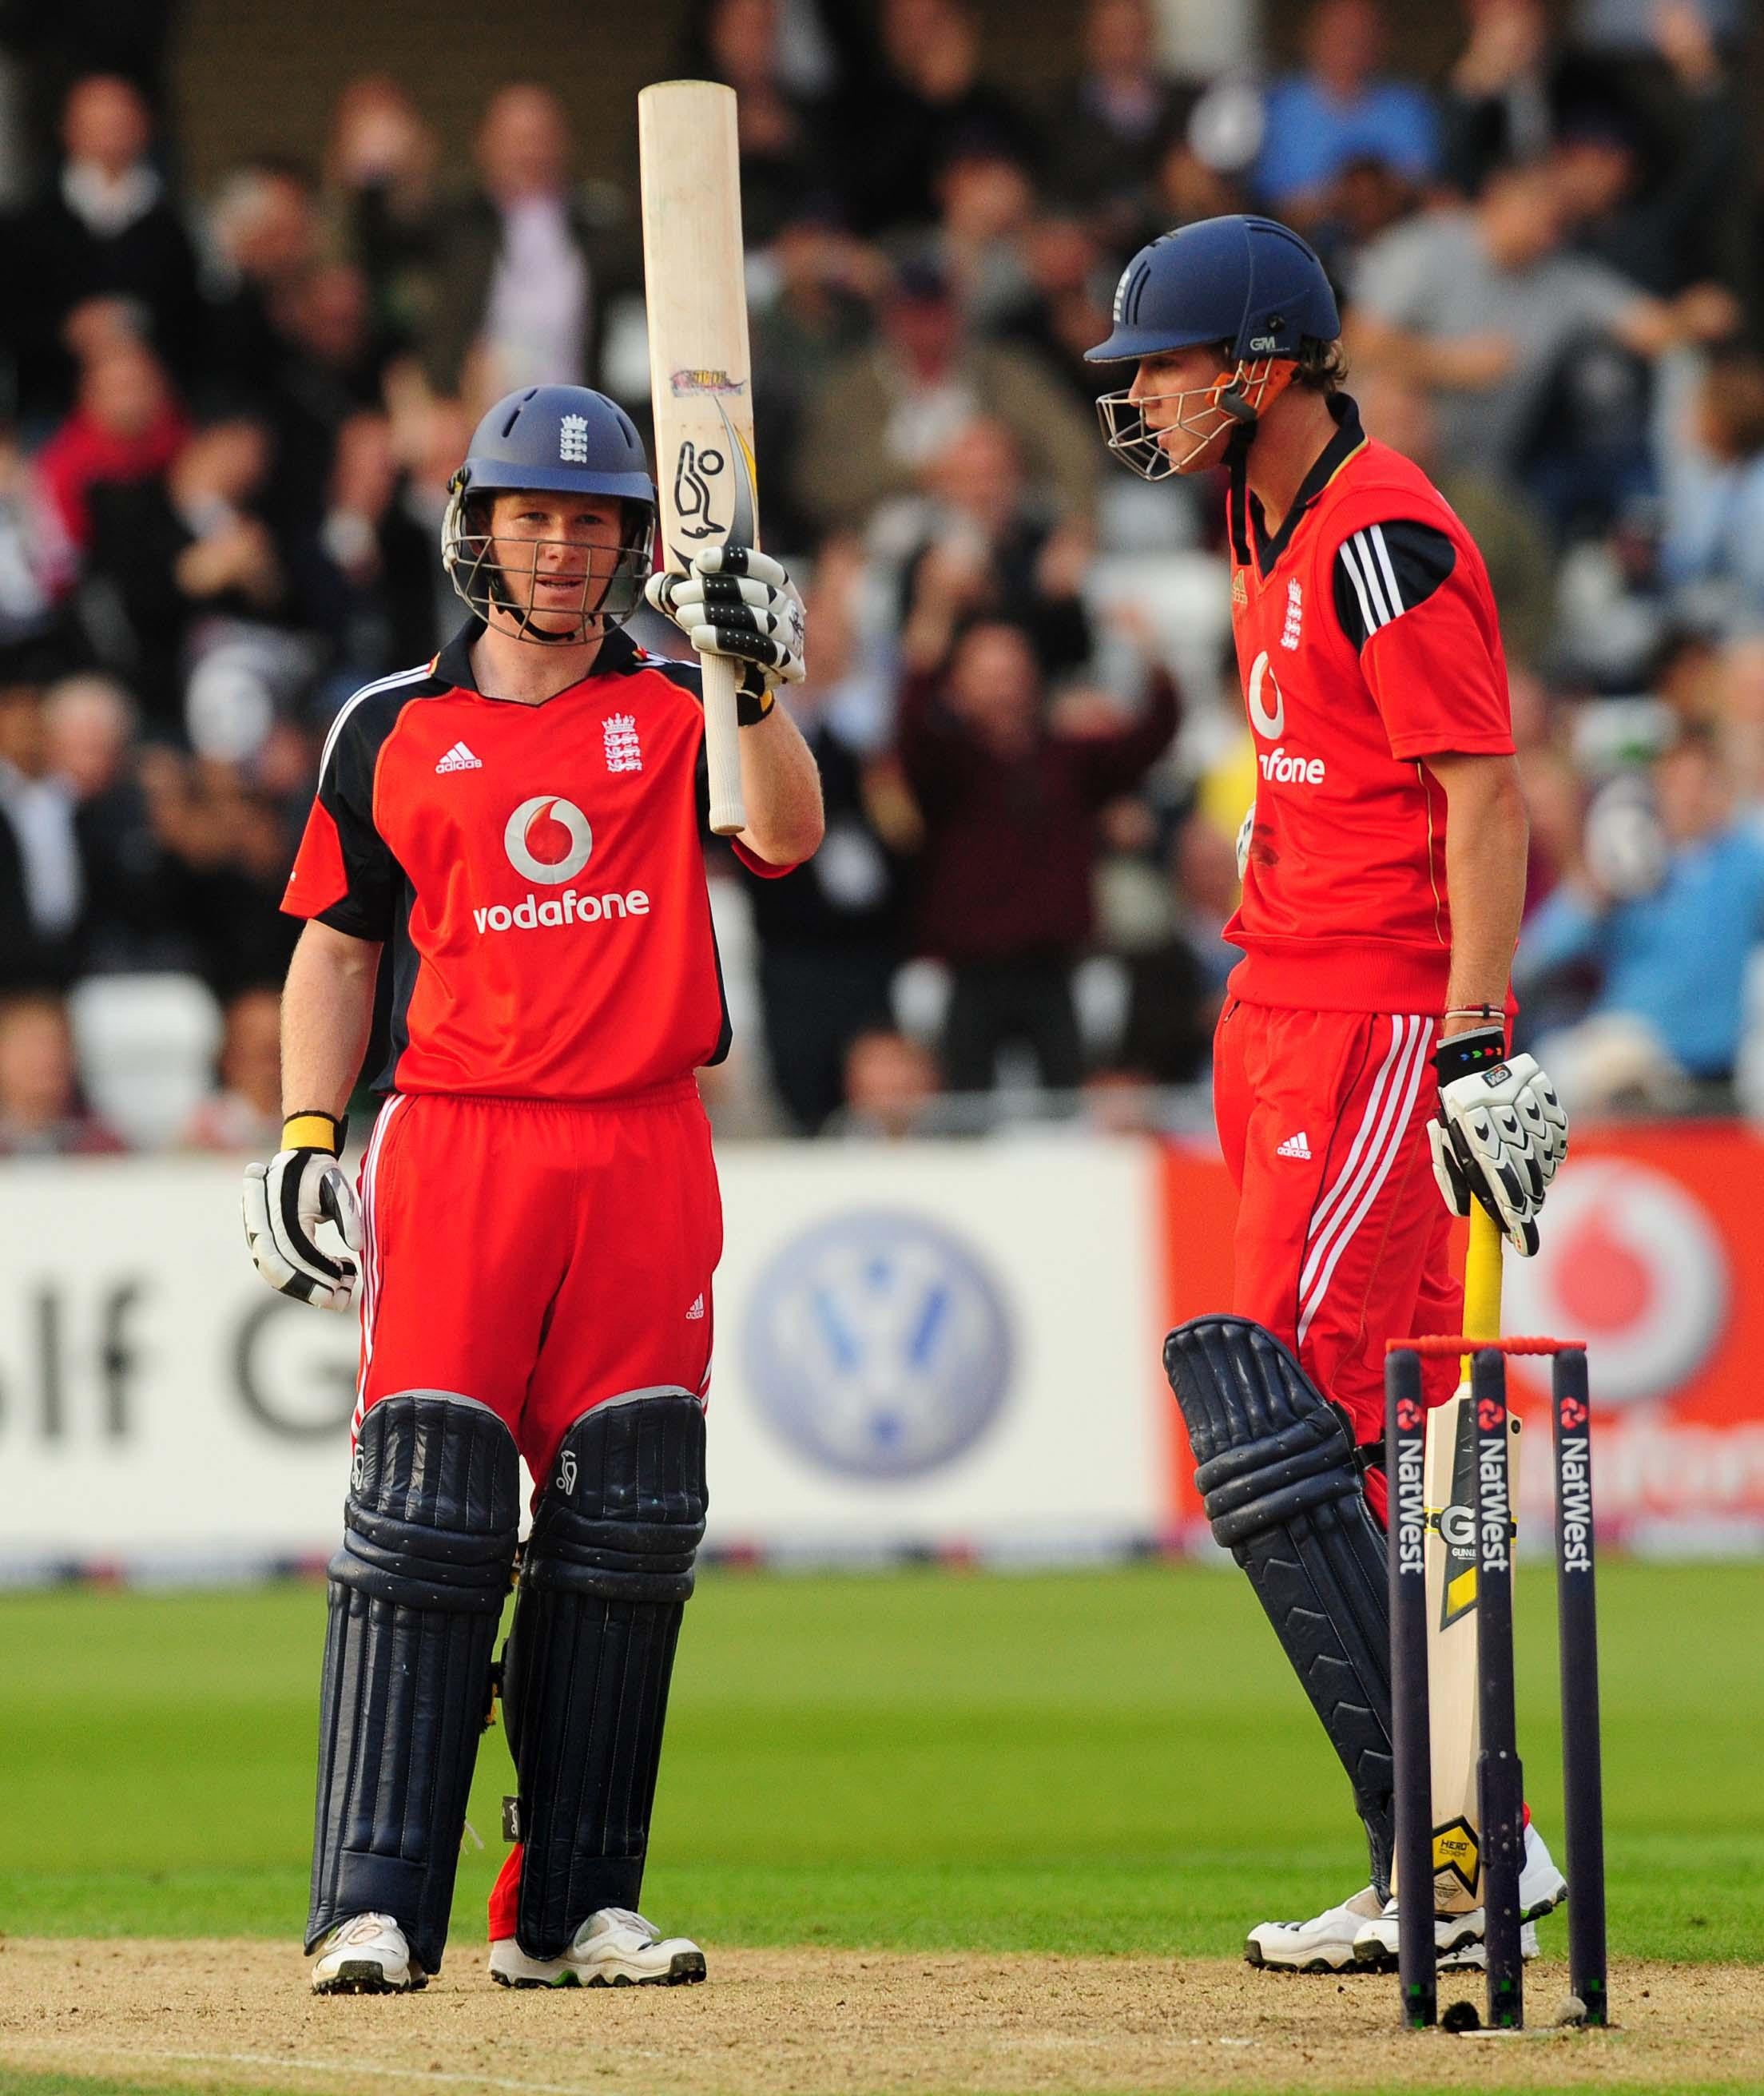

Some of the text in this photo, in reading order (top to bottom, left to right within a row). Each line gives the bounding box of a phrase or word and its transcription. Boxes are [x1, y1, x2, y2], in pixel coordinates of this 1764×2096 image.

[1250, 335, 1275, 351] GM
[435, 759, 483, 774] adidas
[472, 888, 650, 935] vodafone
[1277, 1146, 1312, 1160] adidas
[1397, 1439, 1424, 1574] NatWest
[1479, 1438, 1509, 1572] NatWest
[1561, 1438, 1591, 1572] NatWest
